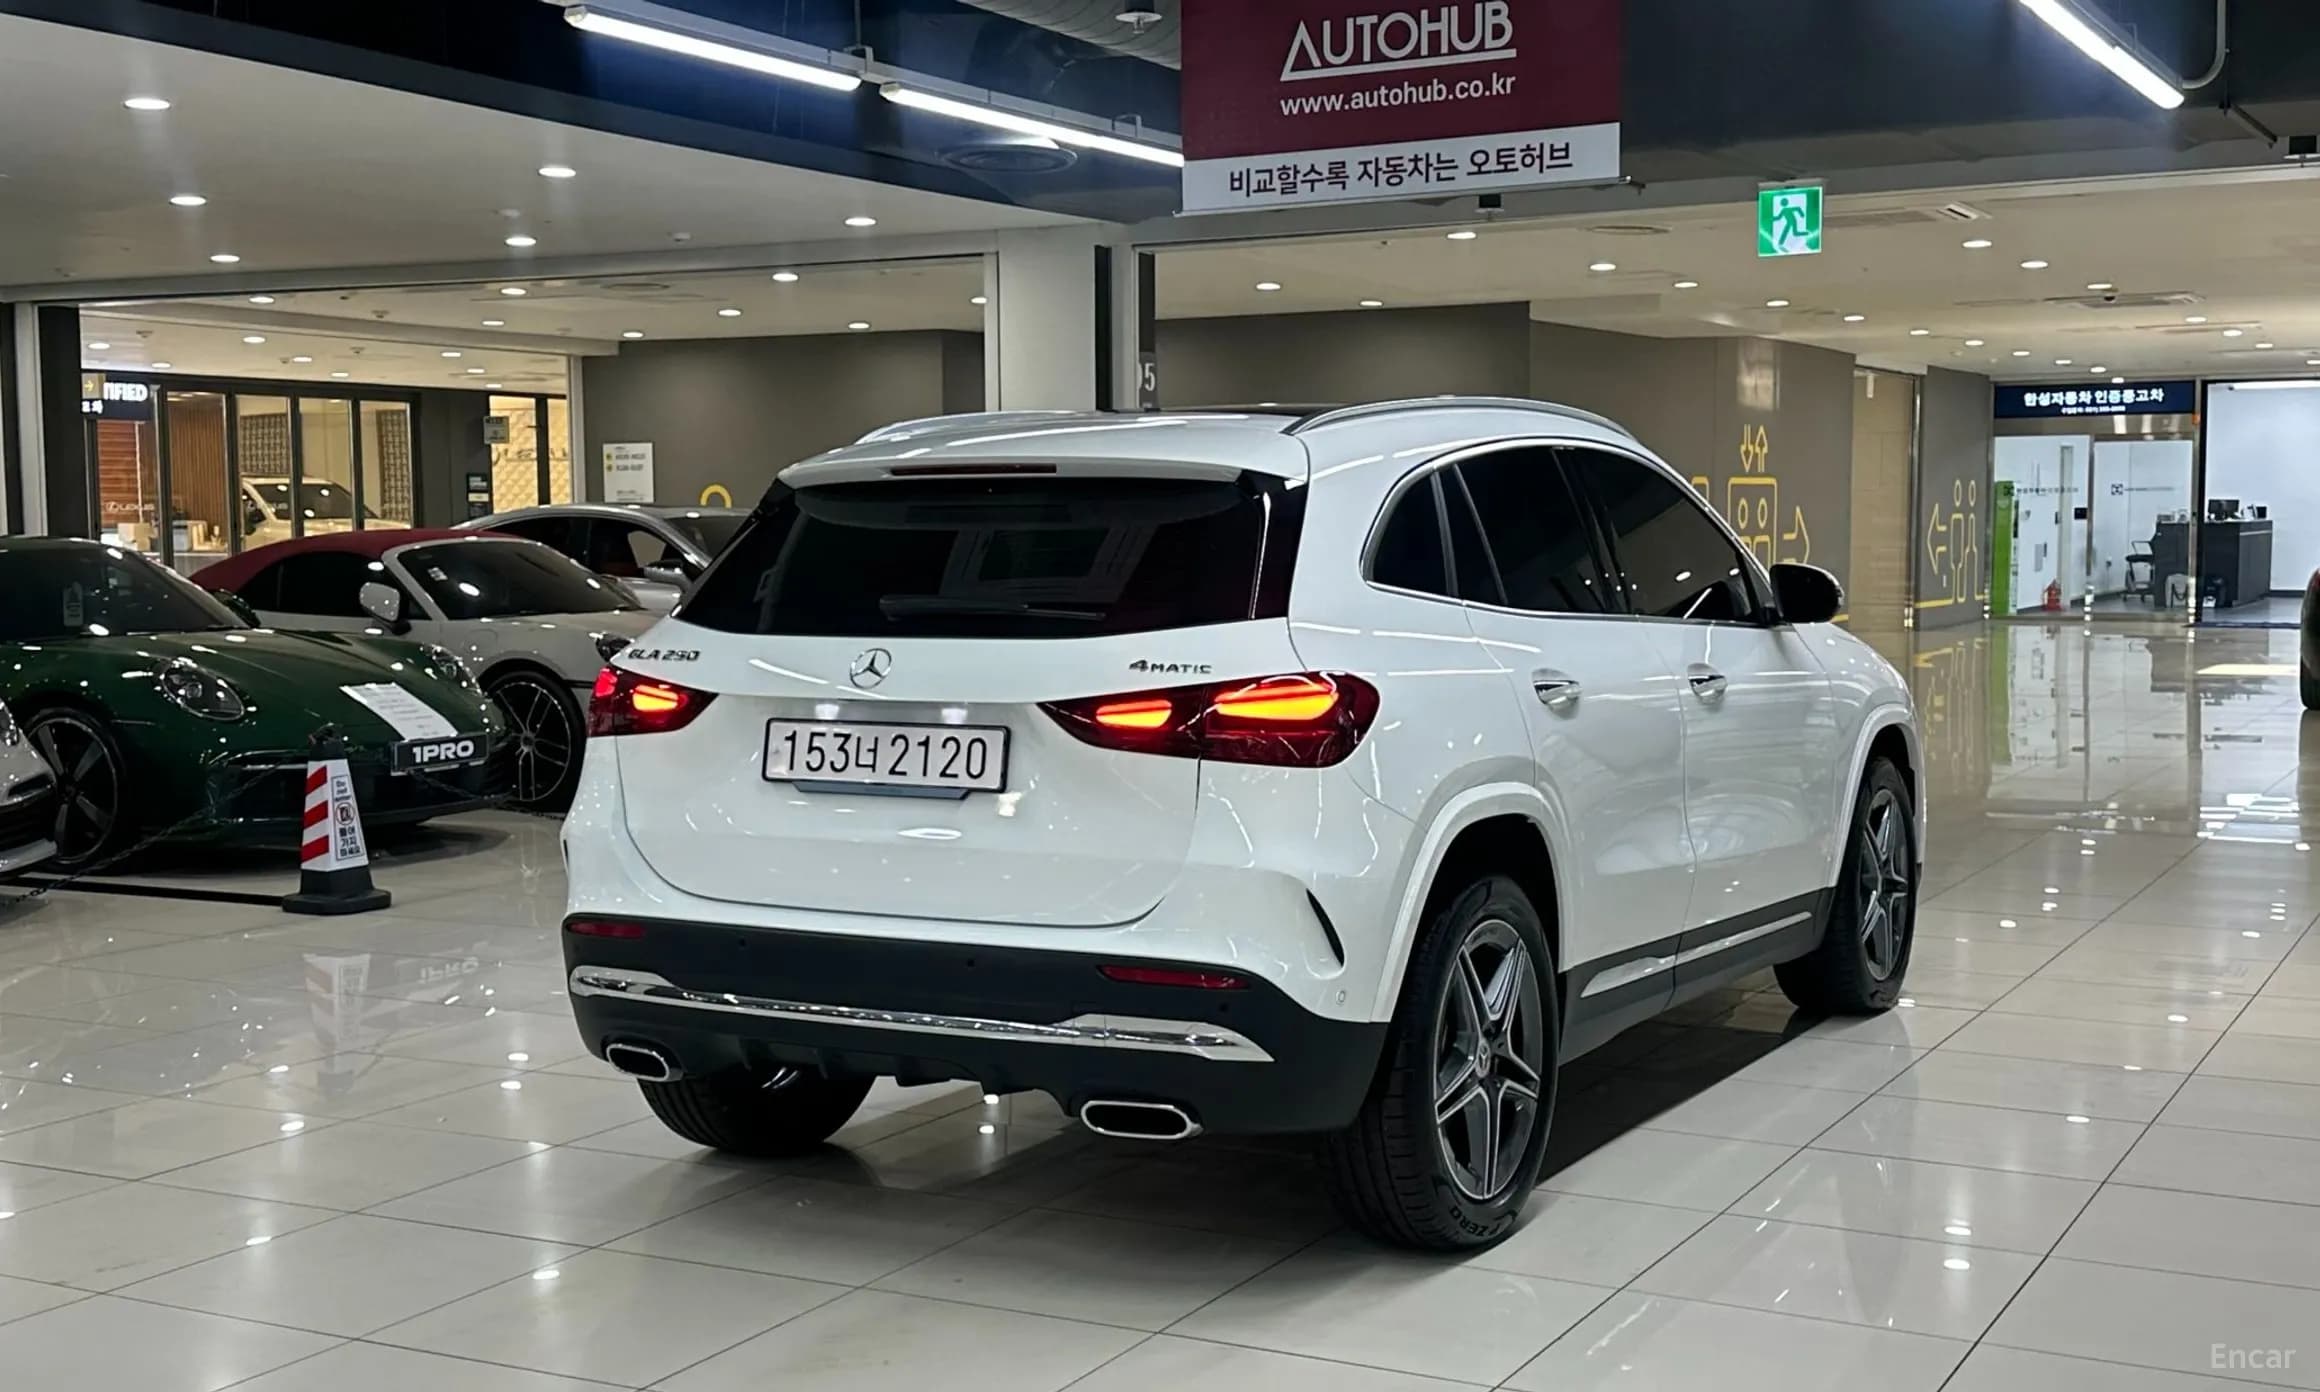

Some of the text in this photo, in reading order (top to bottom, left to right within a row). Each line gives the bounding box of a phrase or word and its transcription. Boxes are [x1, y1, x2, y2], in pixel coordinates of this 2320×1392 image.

[1280, 1, 1517, 82] AUTOHUB
[1280, 72, 1516, 116] www.autohub.co.kr
[1229, 141, 1573, 198] 비교할수록 자동차는 오토허브
[1139, 362, 1156, 392] 5
[628, 648, 701, 661] GLA 250
[1128, 659, 1212, 674] 4MATIC
[412, 739, 475, 764] 1PRO
